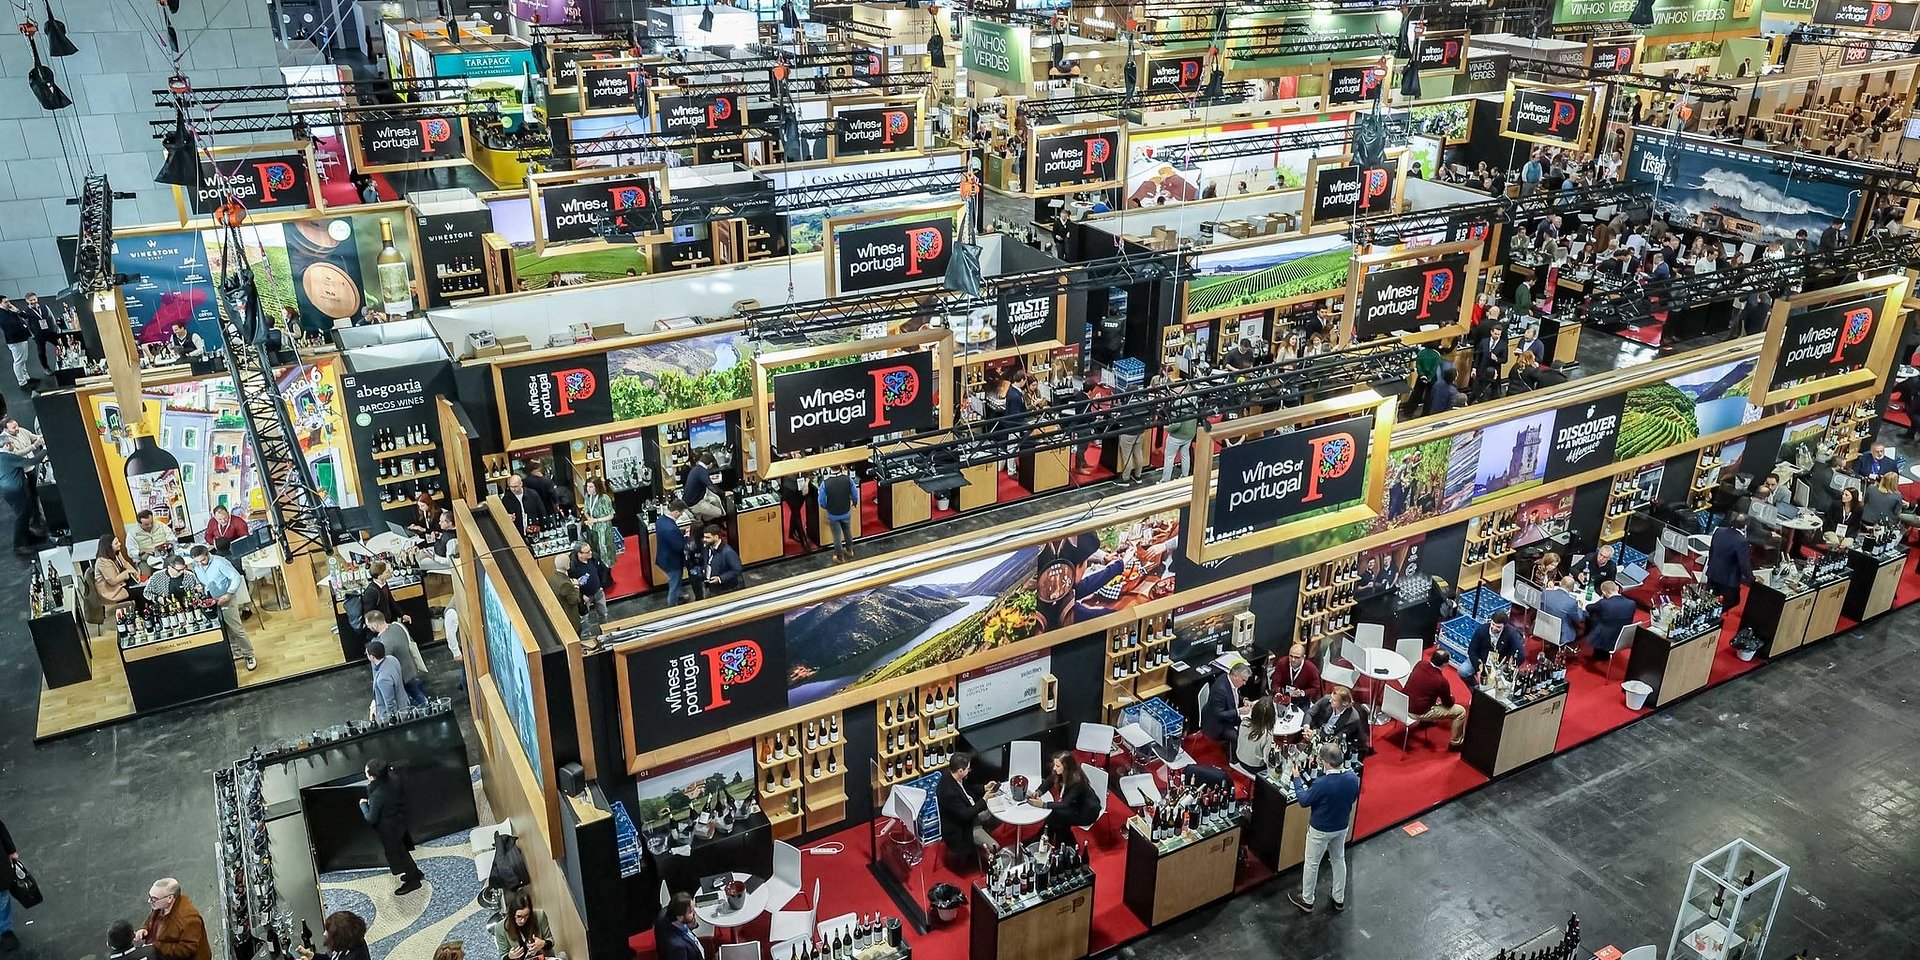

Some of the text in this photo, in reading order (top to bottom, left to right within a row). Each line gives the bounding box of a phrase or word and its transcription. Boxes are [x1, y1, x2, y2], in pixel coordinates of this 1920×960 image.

[1571, 1, 1637, 15] VINHOS VERDE
[1782, 0, 1815, 9] VERD
[1654, 8, 1726, 24] VINHOS VERDES
[971, 31, 1006, 53] VINHOS
[974, 49, 1010, 72] VERDES
[1421, 54, 1443, 63] portugal
[1470, 61, 1495, 72] VINHOS
[1594, 60, 1615, 70] portugal
[597, 78, 623, 87] wines
[1152, 76, 1179, 86] portugal
[1339, 76, 1356, 85] wines
[1470, 70, 1497, 81] VERDES
[593, 86, 628, 98] portugal
[1334, 84, 1360, 95] portugal
[671, 104, 699, 115] wines
[1523, 101, 1546, 114] wines
[667, 112, 705, 128] portugal
[849, 120, 876, 131] wines
[1517, 111, 1549, 125] portugal
[376, 126, 411, 138] wines
[844, 128, 881, 142] portugal
[373, 136, 419, 151] portugal
[1050, 147, 1077, 160] wines
[1045, 156, 1083, 174] portugal
[1641, 159, 1666, 176] LISBO
[812, 168, 913, 185] CASA SANTOS LIMA
[199, 183, 257, 202] portugal
[1330, 180, 1356, 193] wines
[562, 198, 600, 213] wines
[1323, 190, 1361, 208] portugal
[556, 211, 601, 229] portug
[428, 232, 473, 241] WINESTONE
[129, 248, 180, 258] WINESTONE
[857, 242, 896, 259] wines
[850, 252, 905, 277] portugal
[1377, 284, 1412, 301] wines
[1008, 297, 1050, 316] TASTE
[1368, 296, 1418, 322] portugal
[1014, 311, 1039, 322] WORLD
[1040, 309, 1050, 318] OF
[1799, 327, 1831, 345] wines
[1786, 338, 1836, 367] portugal
[356, 378, 422, 399] abegoaria
[537, 373, 555, 418] portugal
[359, 396, 425, 413] BARCOS WINES
[528, 382, 540, 415] wines
[800, 388, 865, 410] wines of
[790, 400, 866, 433] portugal
[1557, 415, 1617, 444] DISCOVER
[1564, 430, 1605, 450] A WORLD OF
[1242, 459, 1304, 484] wines of
[1229, 471, 1302, 512] portugal
[665, 657, 682, 713] wines of
[680, 653, 703, 716] portugal
